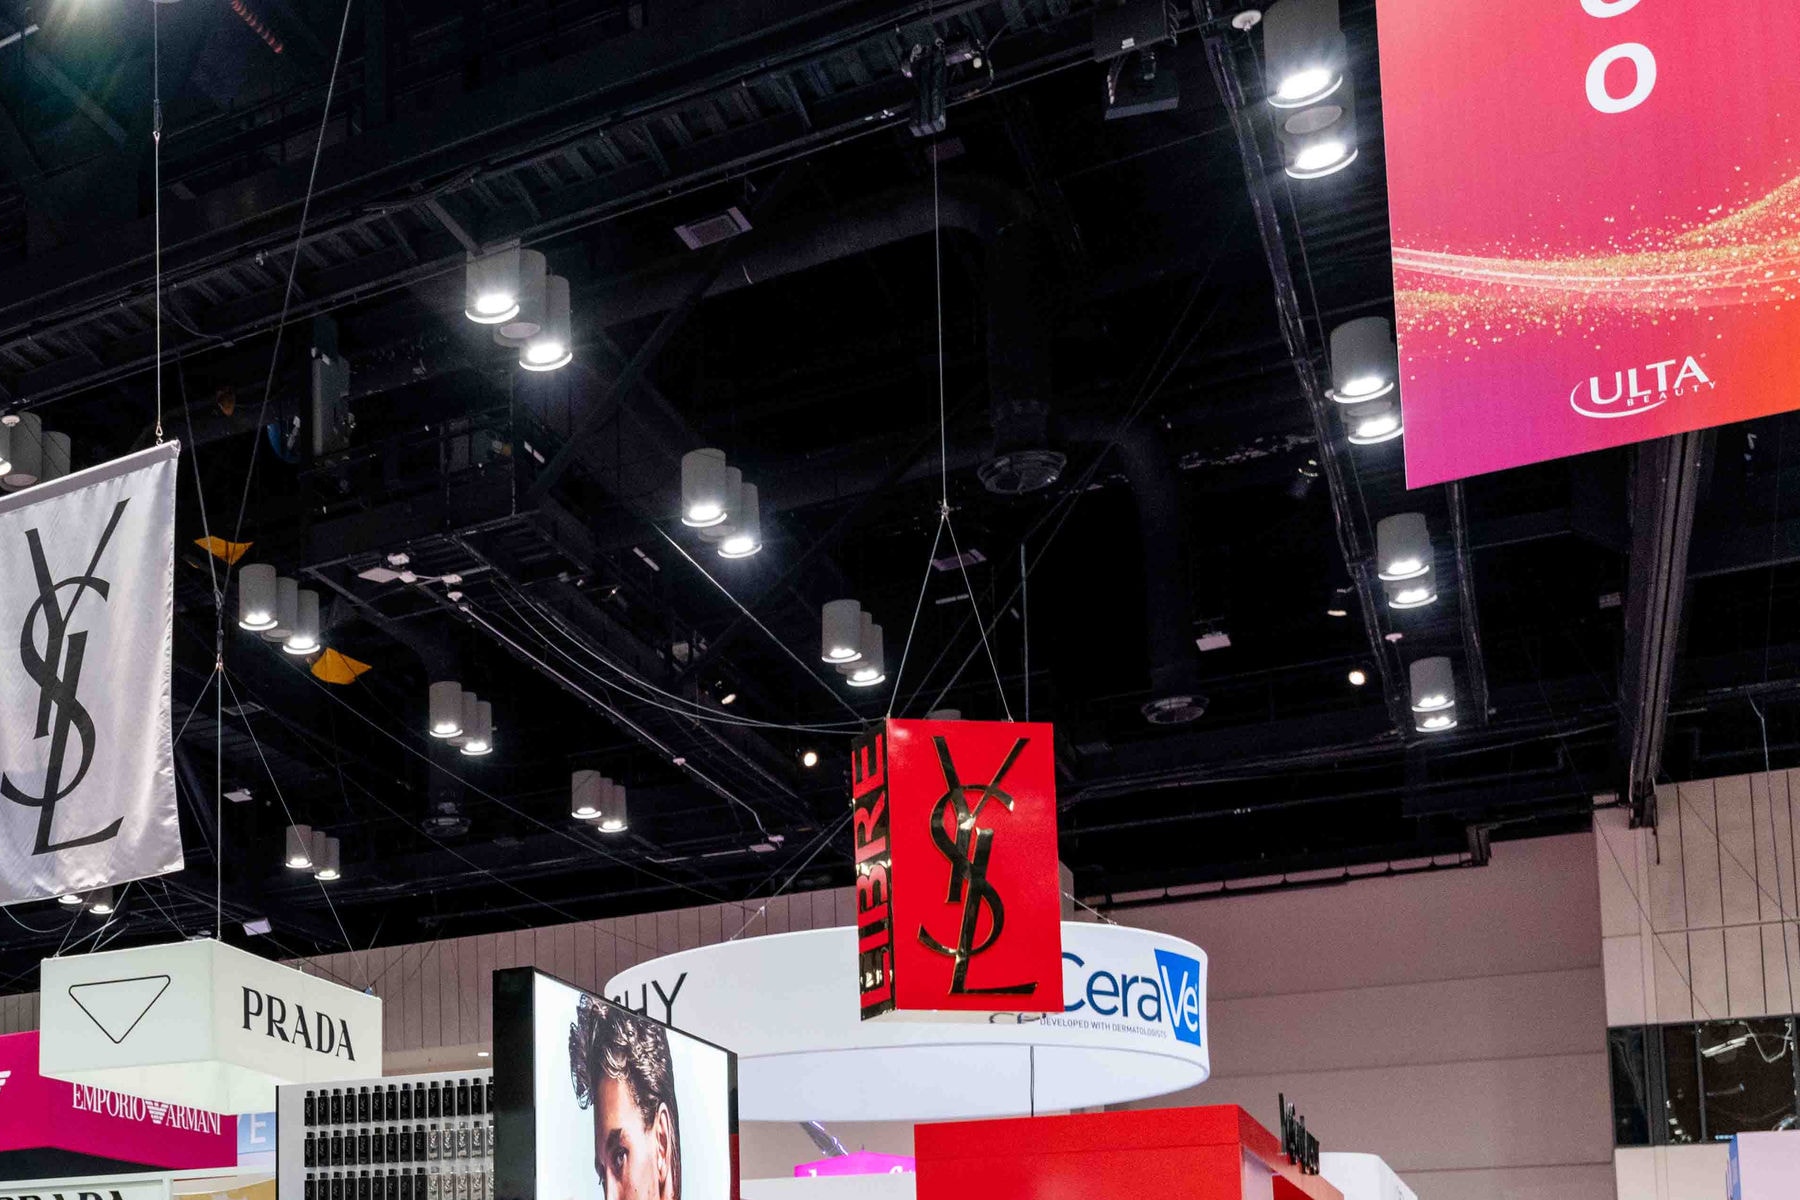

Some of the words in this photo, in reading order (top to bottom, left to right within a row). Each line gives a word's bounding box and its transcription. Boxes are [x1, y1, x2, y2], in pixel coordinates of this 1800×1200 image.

[1589, 355, 1710, 405] ULTA
[1626, 381, 1717, 407] BEAUTY
[852, 733, 894, 1012] LIBRE
[241, 985, 356, 1062] PRADA
[1039, 1017, 1089, 1030] DEVELOPED
[1090, 1021, 1111, 1031] WITH
[1112, 1023, 1168, 1040] DERMATOLOGISTS
[72, 1082, 146, 1122] EMPORIO
[165, 1103, 222, 1136] ARMANI
